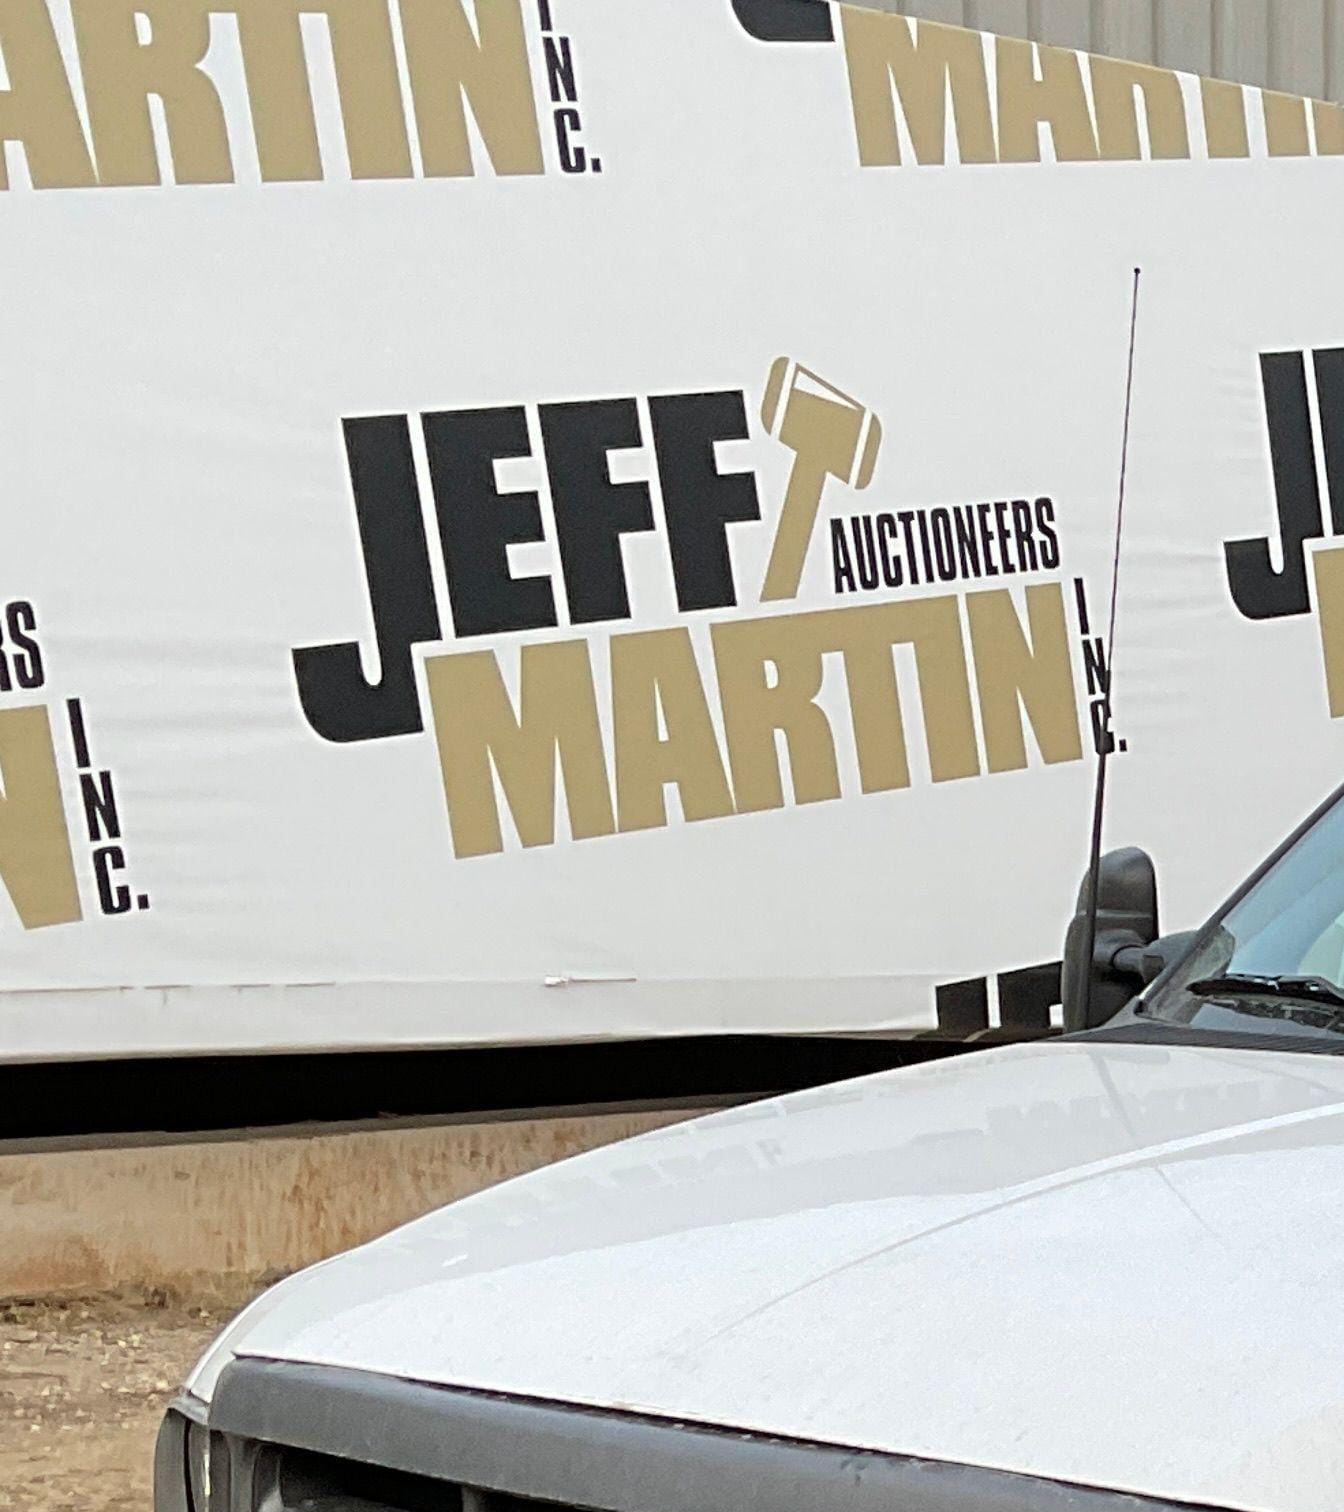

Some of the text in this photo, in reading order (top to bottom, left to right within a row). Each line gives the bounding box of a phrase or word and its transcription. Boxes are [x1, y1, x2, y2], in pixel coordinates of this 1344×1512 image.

[0, 0, 546, 190] ARTIN
[291, 389, 762, 743] JEFF
[830, 496, 1060, 594] AUCTIONEERS
[424, 582, 1083, 860] MARTIN
[1074, 577, 1128, 755] INC.
[66, 697, 150, 915] INC.
